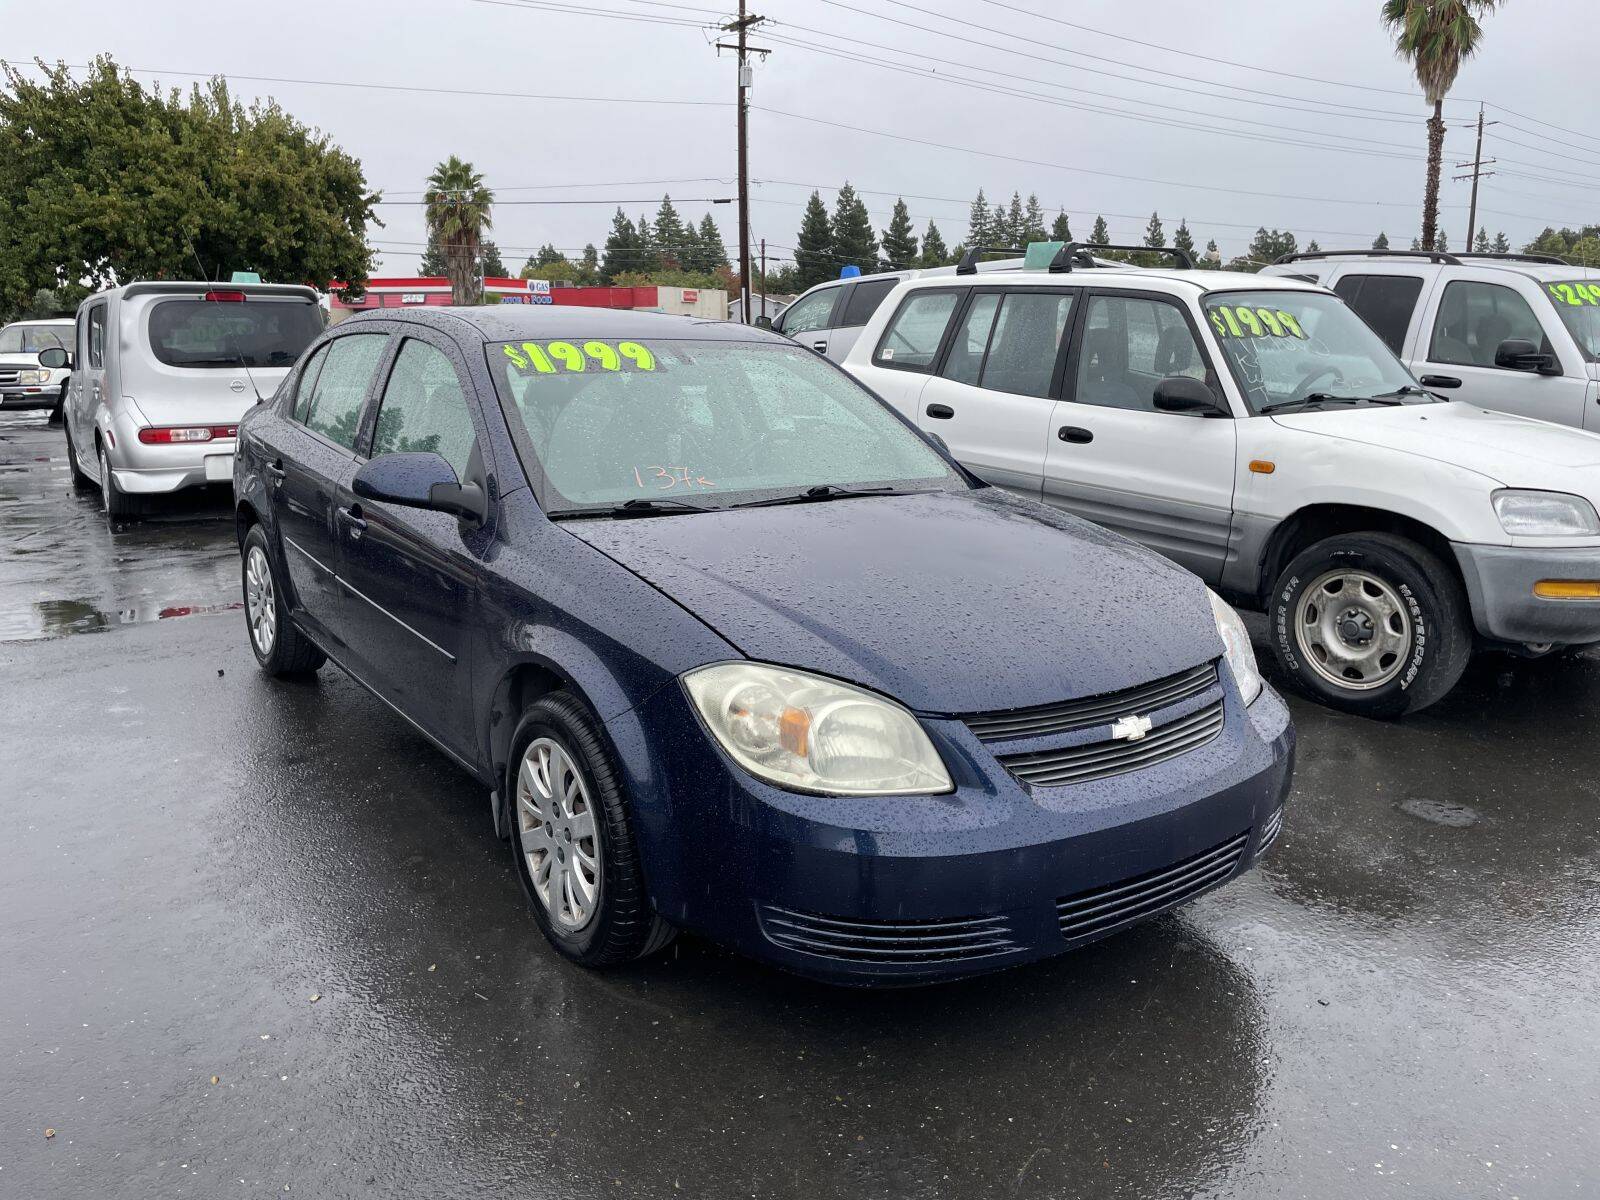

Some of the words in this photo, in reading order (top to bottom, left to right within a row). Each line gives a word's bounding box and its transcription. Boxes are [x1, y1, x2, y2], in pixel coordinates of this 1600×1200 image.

[531, 294, 553, 304] FOOD
[536, 282, 549, 292] GAS
[1210, 306, 1309, 340] $1999
[503, 341, 656, 374] $1999
[1399, 583, 1425, 690] MASTERCRAFT
